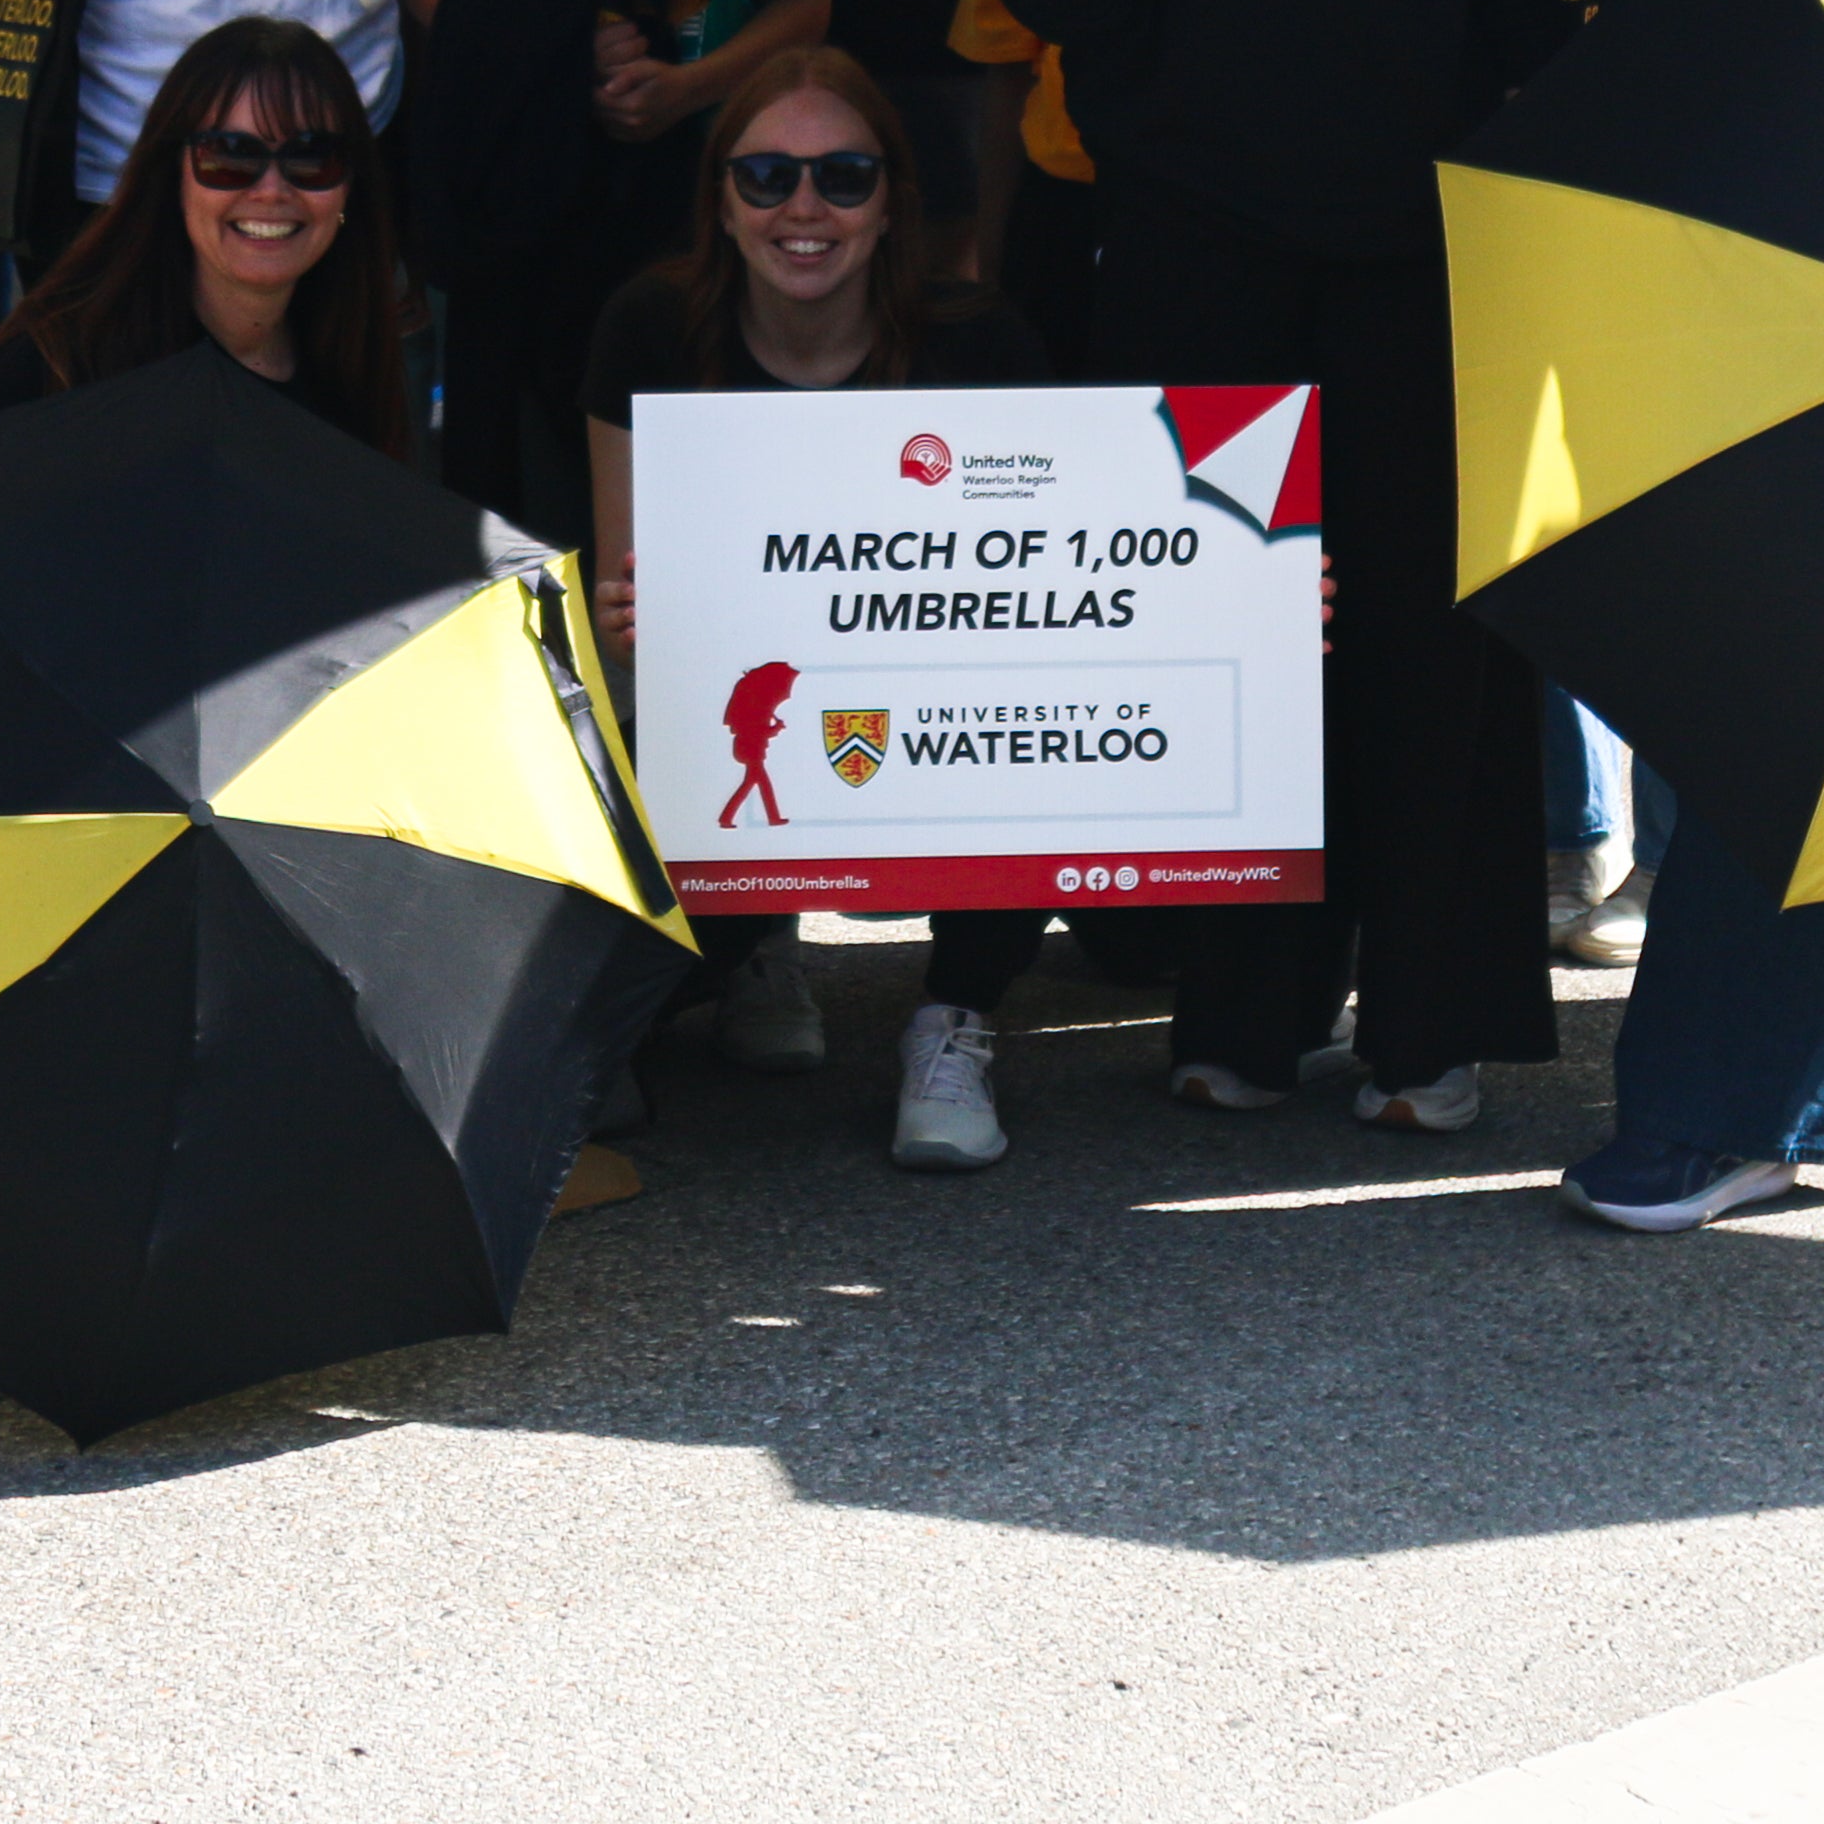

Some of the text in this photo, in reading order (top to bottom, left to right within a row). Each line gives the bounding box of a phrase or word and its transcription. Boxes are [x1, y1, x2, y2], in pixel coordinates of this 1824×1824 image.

[962, 455, 1054, 471] United Way
[962, 475, 1057, 488] Waterloo Region
[962, 489, 1035, 500] Communities
[762, 526, 1199, 574] MARCH OF 1,000
[829, 588, 1137, 633] UMBRELLAS
[917, 703, 1152, 724] UNIVERSITY OF
[901, 727, 1169, 766] WATERLOO
[681, 875, 870, 892] #MarchOf1000Umbrellas
[1148, 866, 1281, 885] @UnitedWayWRC
